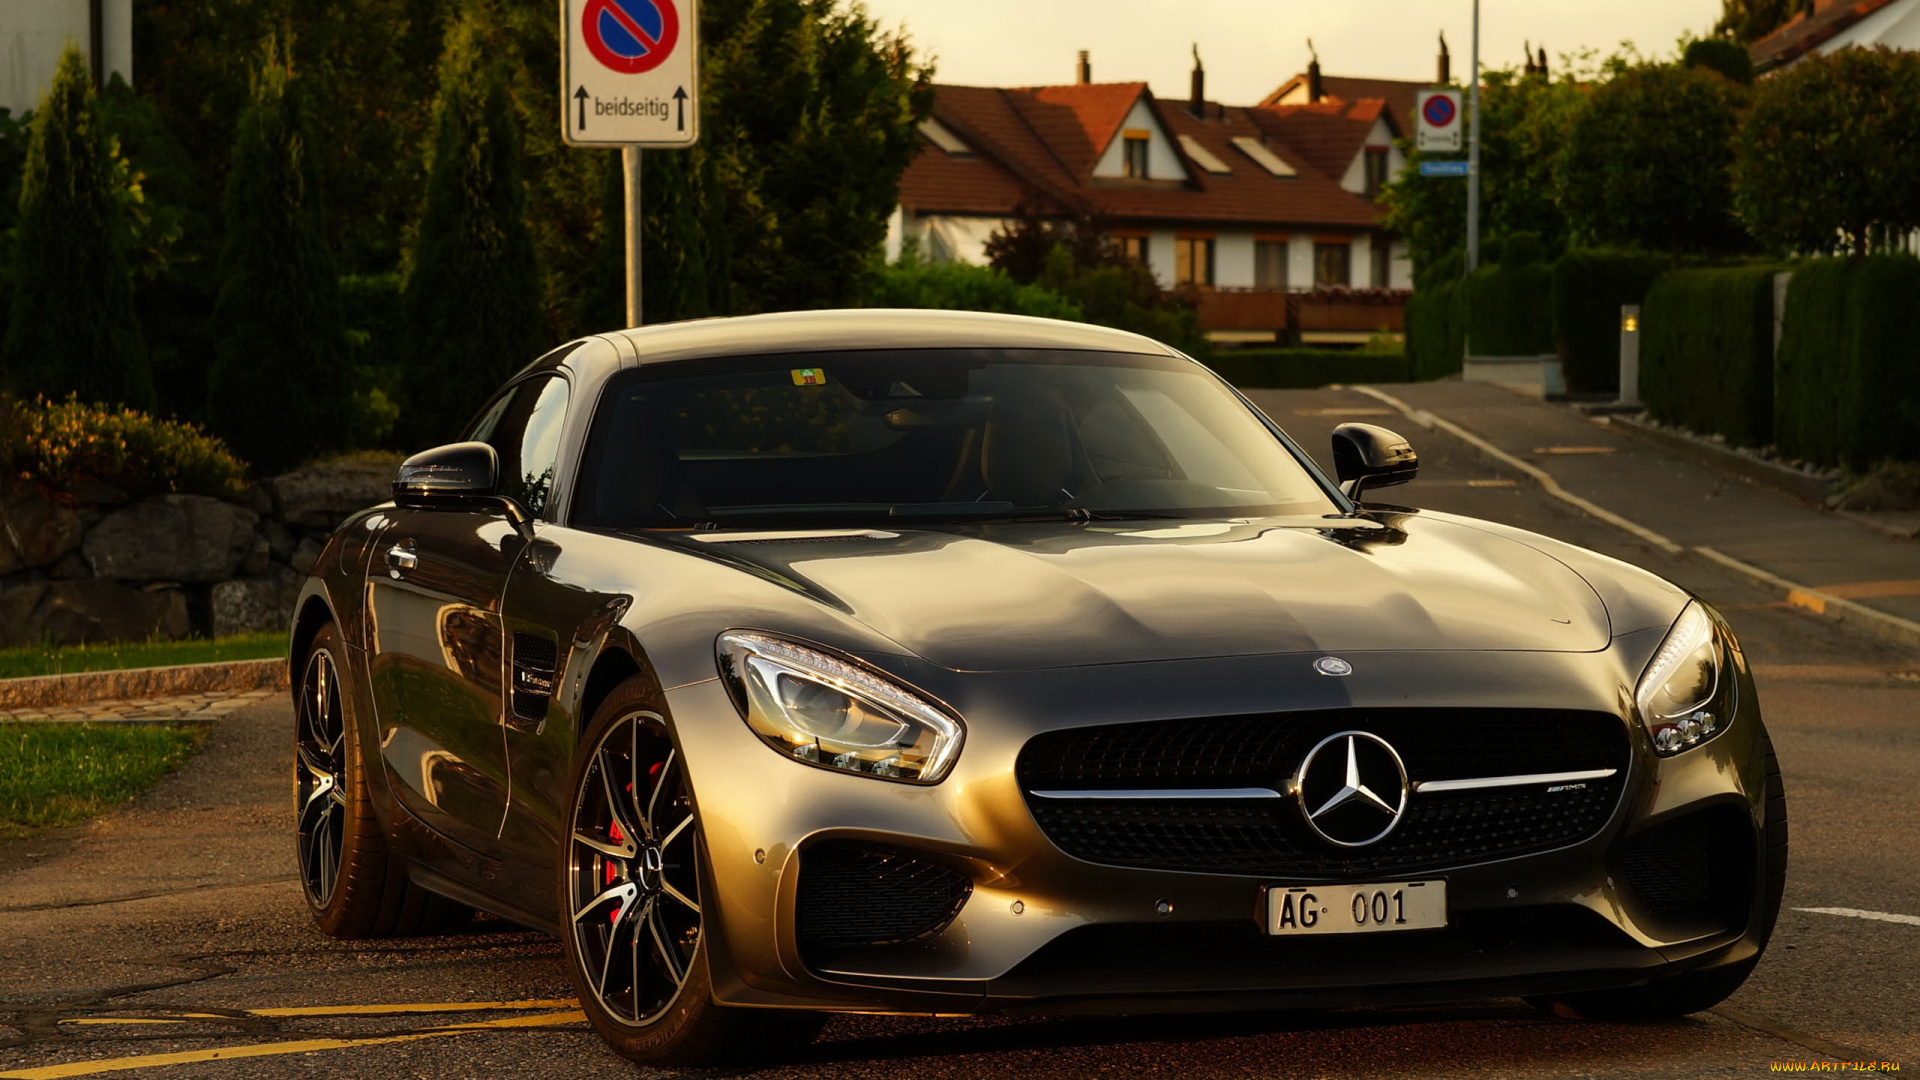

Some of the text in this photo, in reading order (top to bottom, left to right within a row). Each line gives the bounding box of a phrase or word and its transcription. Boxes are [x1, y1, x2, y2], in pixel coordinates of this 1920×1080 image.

[595, 97, 669, 121] beidseitig
[1278, 889, 1407, 929] AG 001
